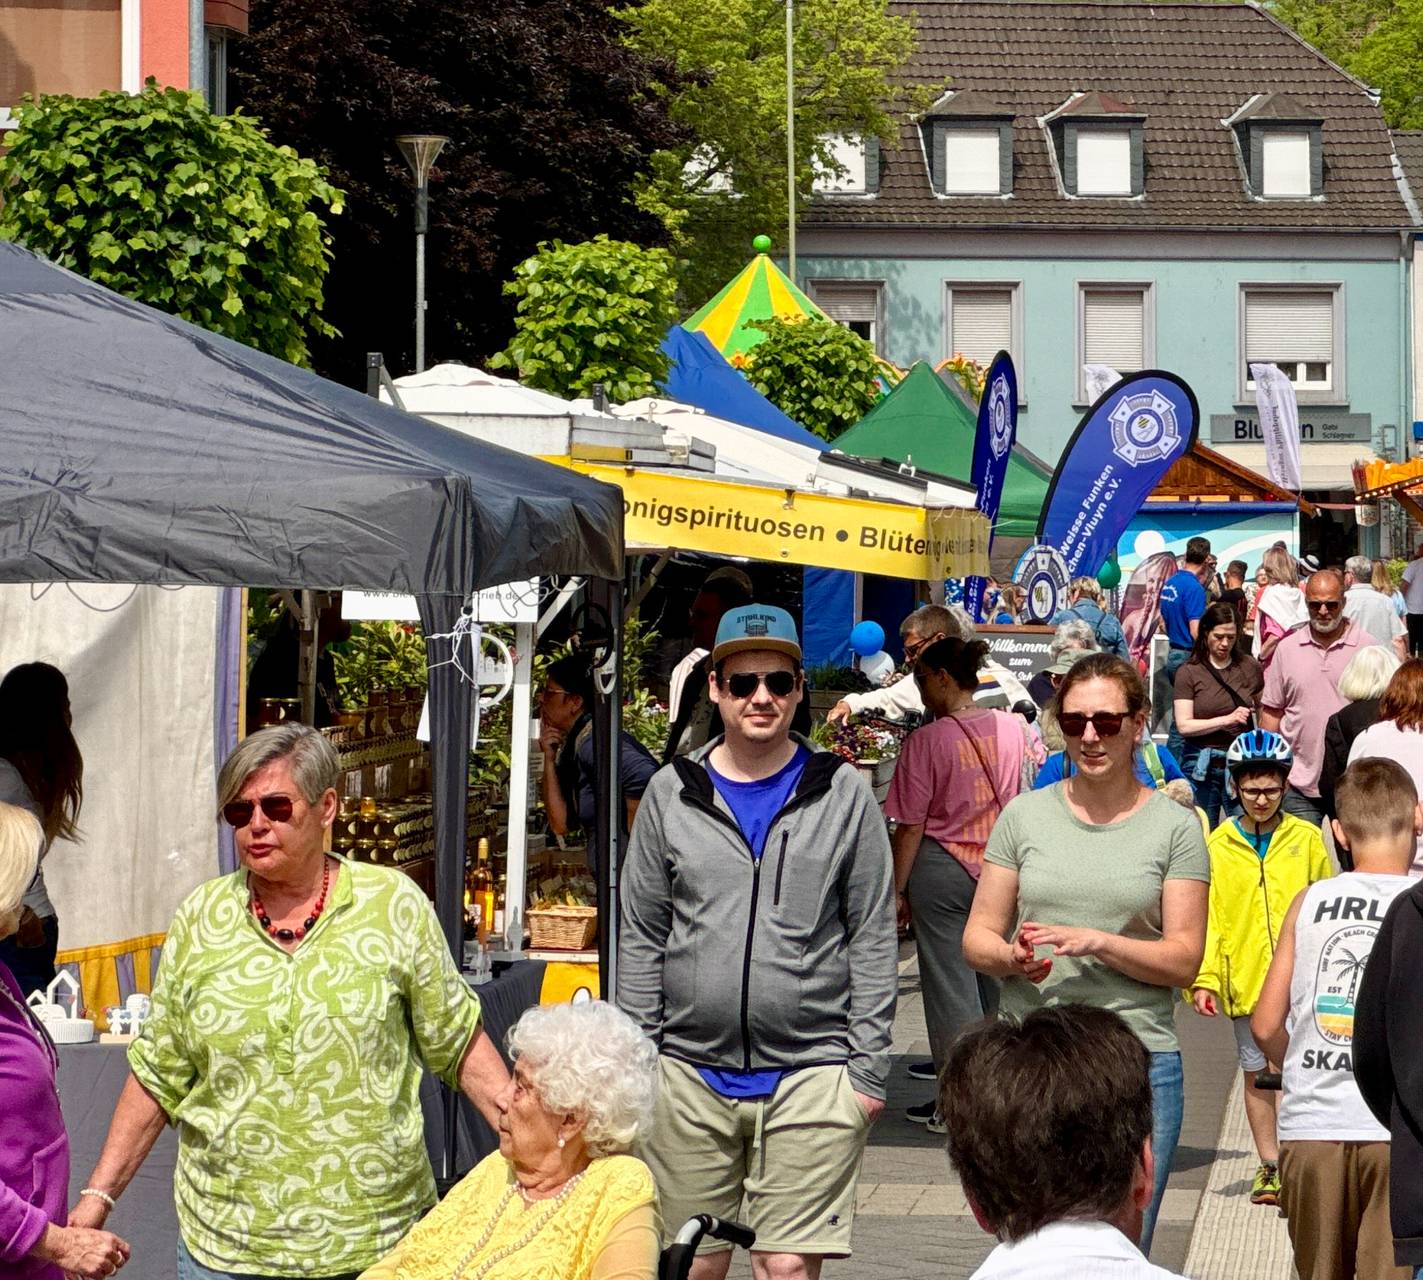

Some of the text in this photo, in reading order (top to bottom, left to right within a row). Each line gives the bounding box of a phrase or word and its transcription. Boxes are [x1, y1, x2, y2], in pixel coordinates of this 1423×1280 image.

[1234, 420, 1314, 439] Blun
[1060, 464, 1114, 556] Weisse Funken
[1068, 478, 1122, 573] chen-Vluyn e.V.
[1018, 671, 1036, 681] Sch
[1327, 986, 1342, 994] EST
